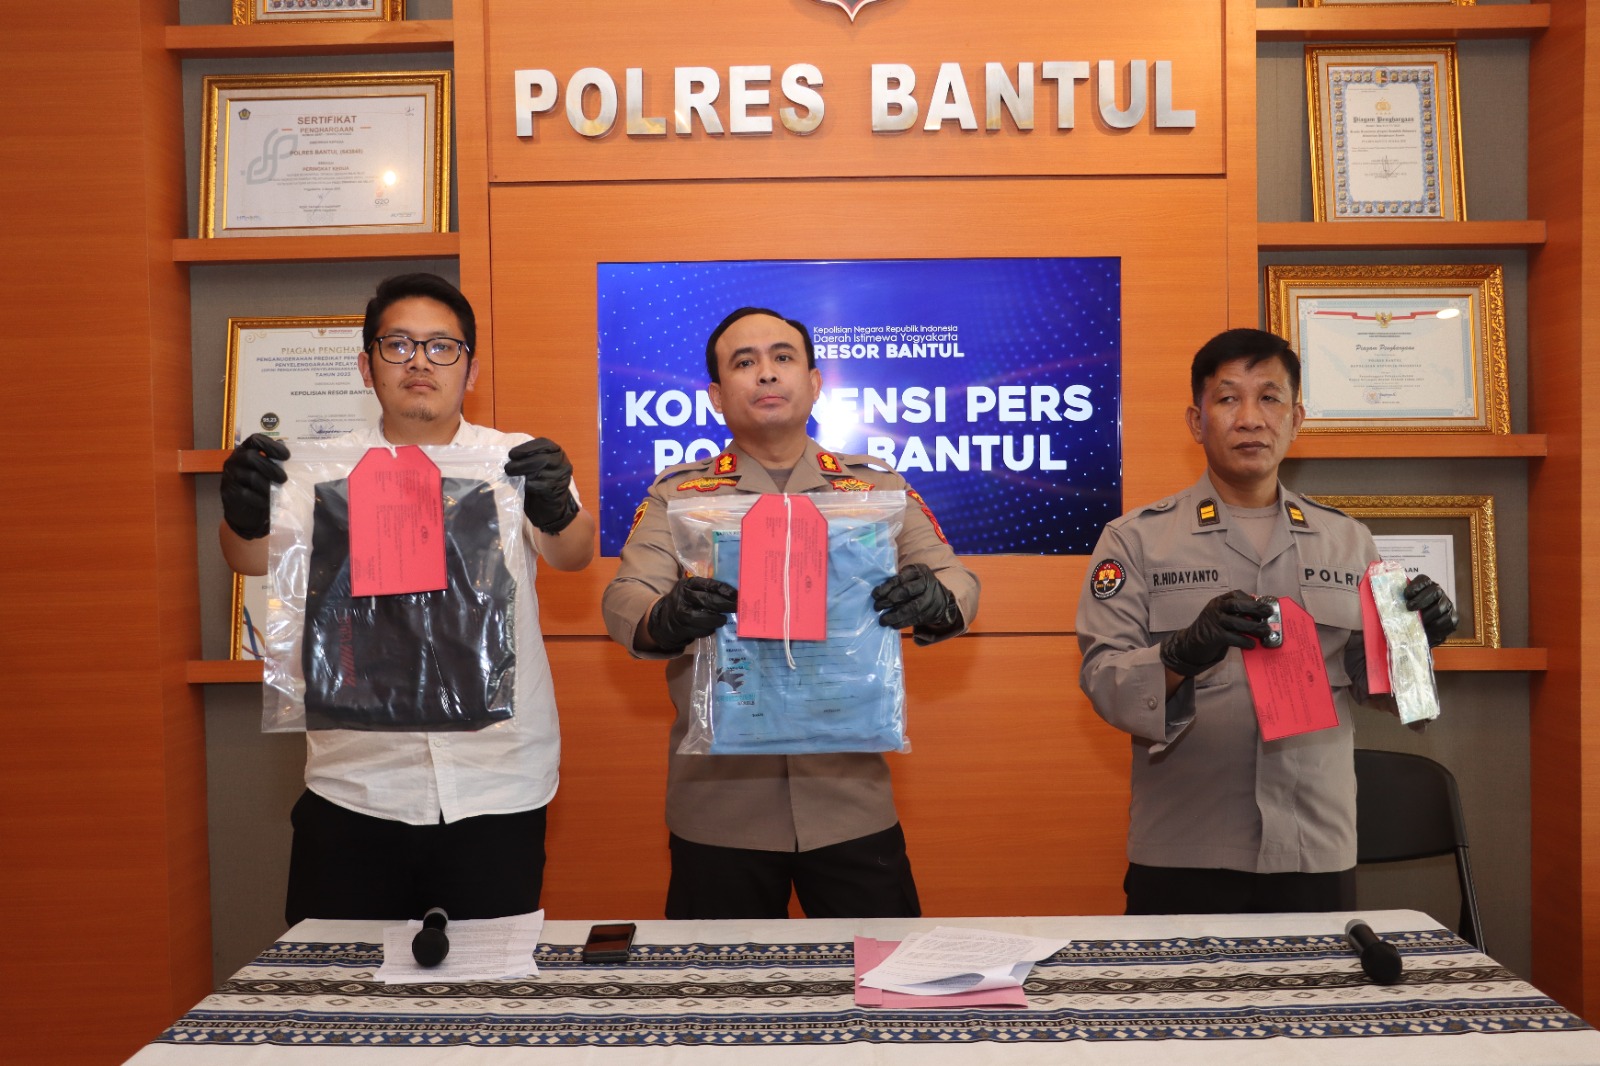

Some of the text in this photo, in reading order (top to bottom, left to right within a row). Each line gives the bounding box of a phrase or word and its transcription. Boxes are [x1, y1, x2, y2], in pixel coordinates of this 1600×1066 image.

[514, 60, 1196, 138] POLRES BANTUL
[297, 115, 357, 125] SERTIFIKAT
[813, 324, 958, 336] Kepolisian Negara Republik Indonesia
[813, 333, 958, 344] Daerah Istimewa Yogyakarta
[281, 347, 315, 355] PIAGAM
[886, 343, 965, 359] BANTUL
[966, 384, 1094, 422] PERS
[867, 434, 1068, 472] BANTUL
[1153, 569, 1219, 587] R.HIDAYANTO
[1304, 568, 1360, 587] POLRI
